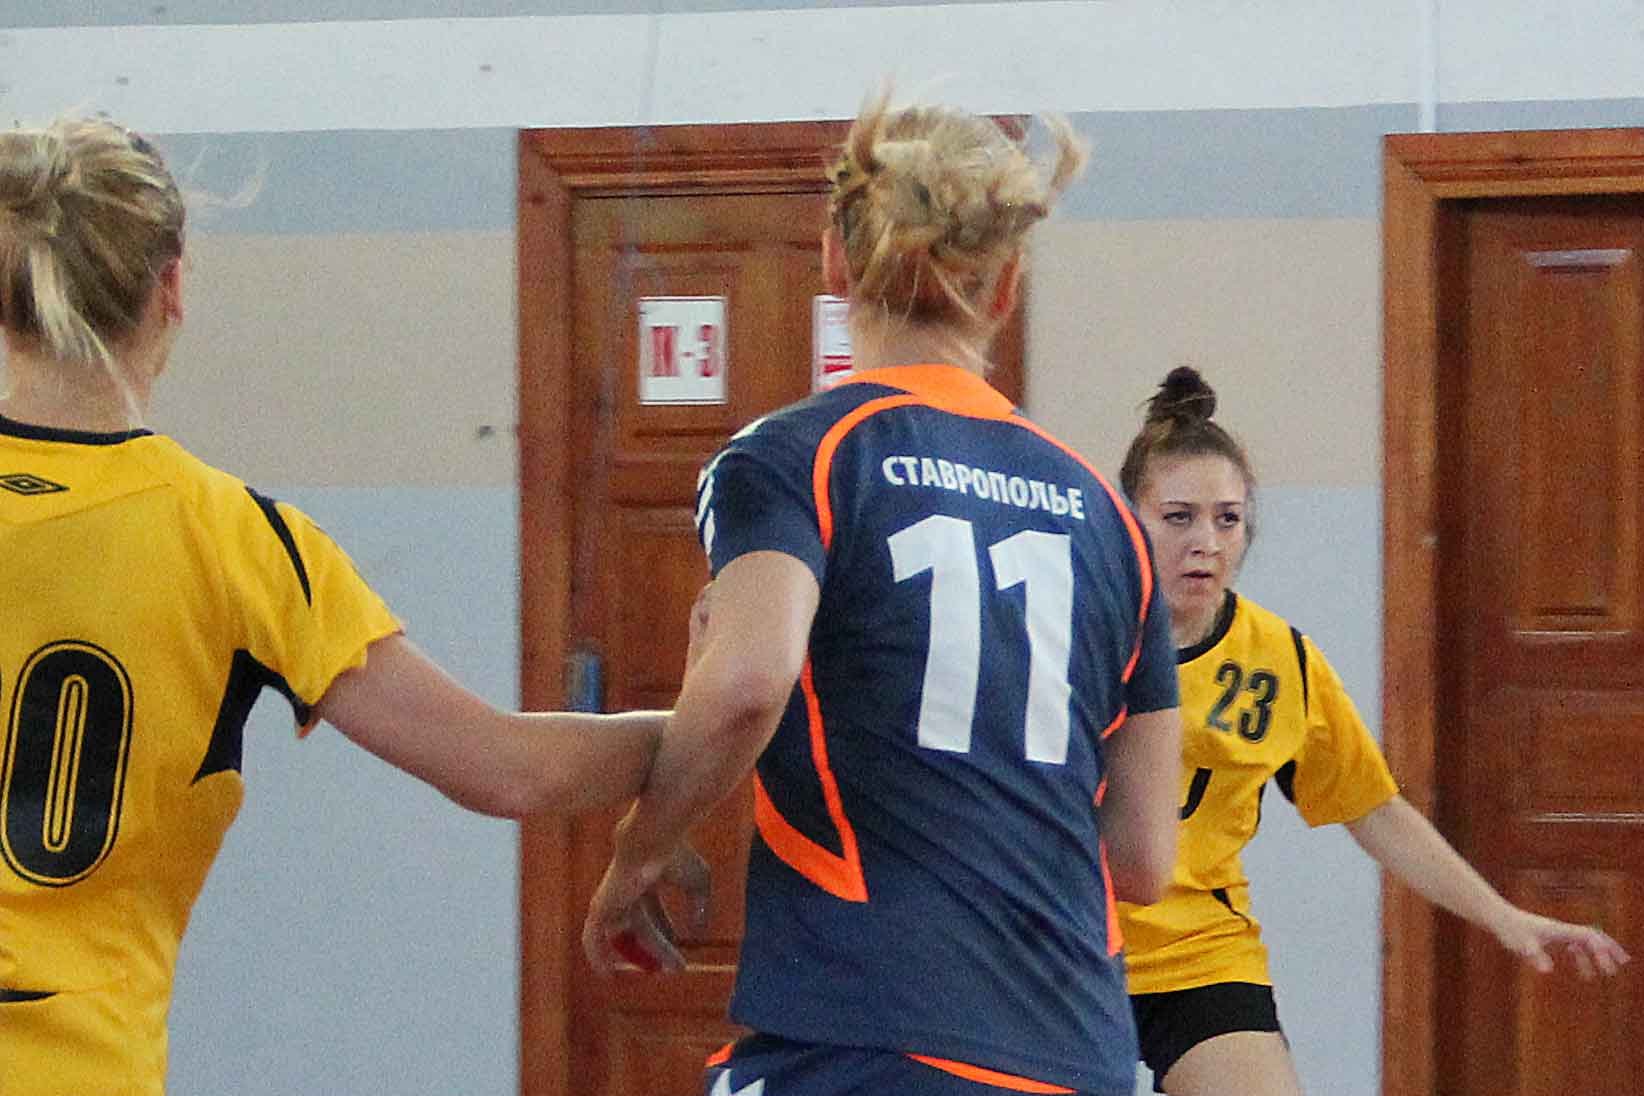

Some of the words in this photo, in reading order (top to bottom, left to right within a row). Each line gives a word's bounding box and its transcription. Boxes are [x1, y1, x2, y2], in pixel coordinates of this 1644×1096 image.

[882, 456, 1085, 520] СТАВРОПОЛЬЕ
[887, 514, 1074, 765] 11
[1206, 658, 1279, 743] 23
[0, 639, 133, 888] 0
